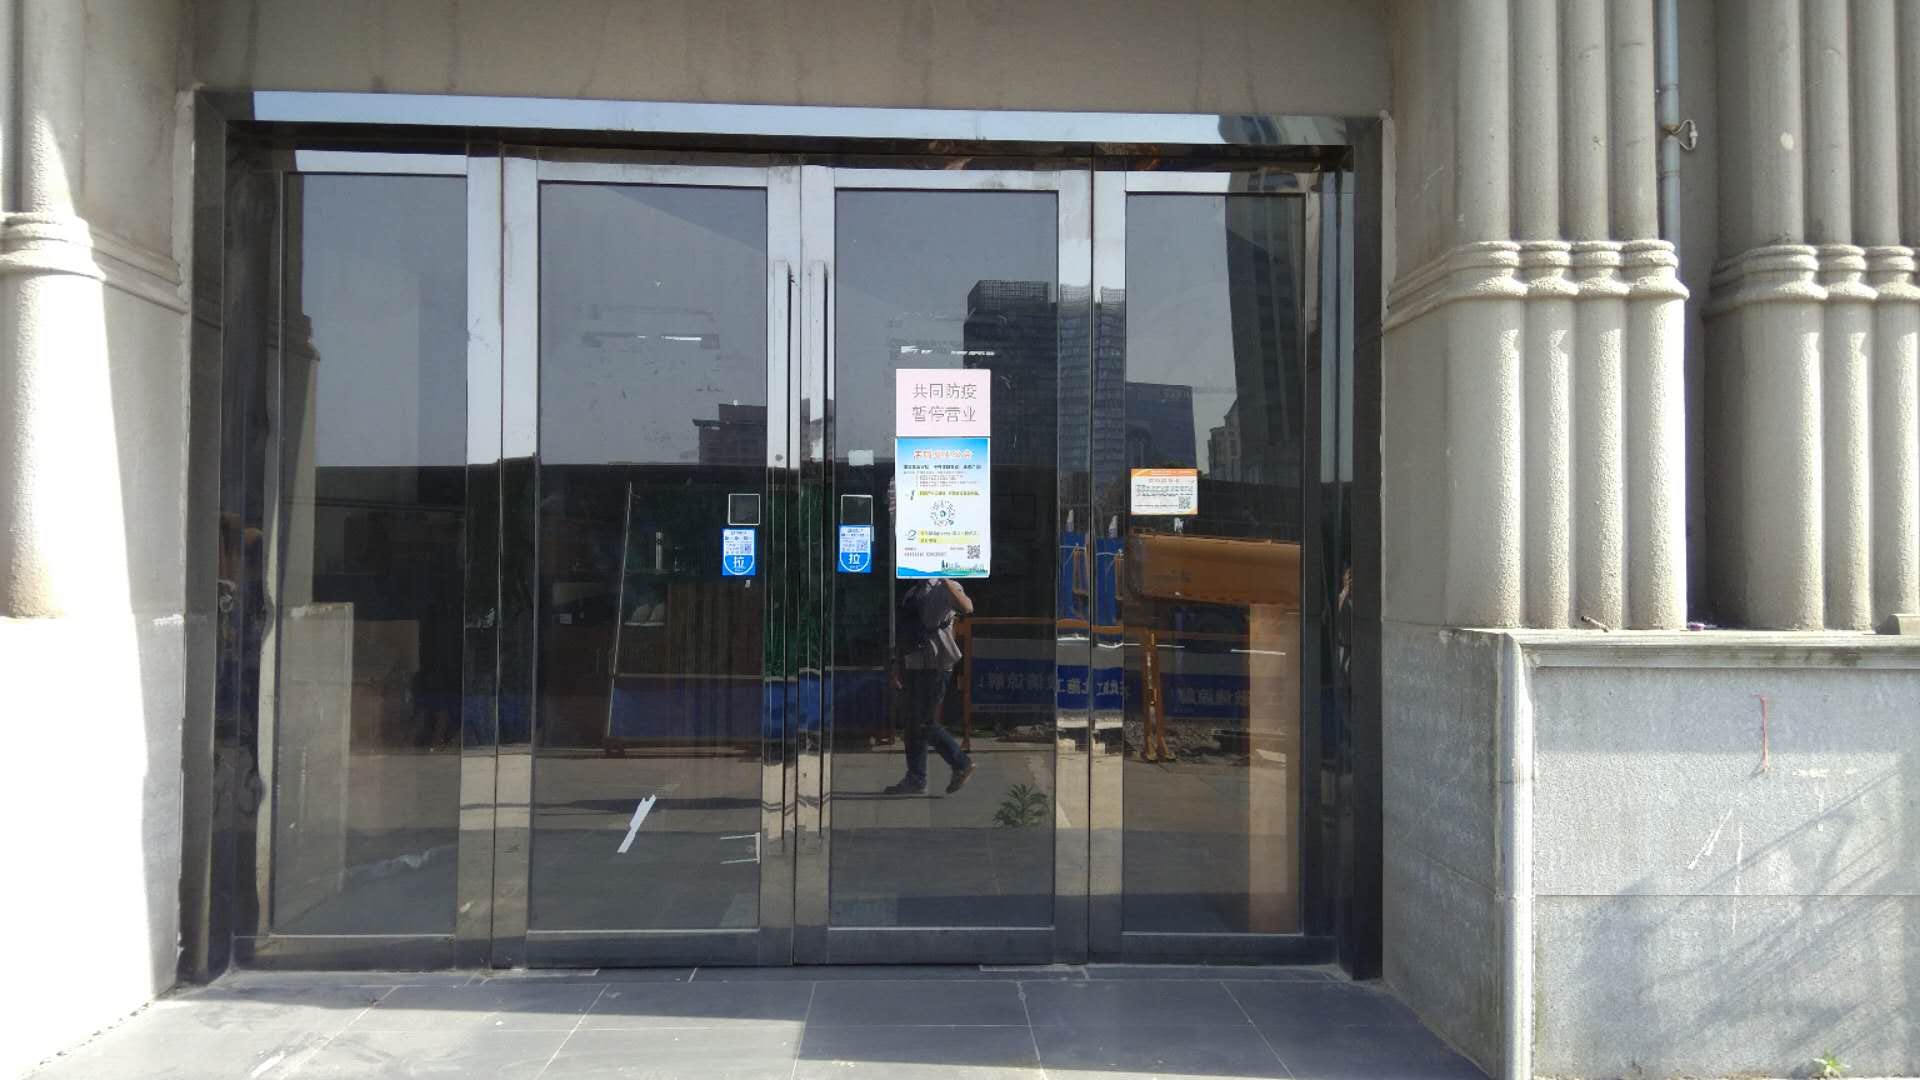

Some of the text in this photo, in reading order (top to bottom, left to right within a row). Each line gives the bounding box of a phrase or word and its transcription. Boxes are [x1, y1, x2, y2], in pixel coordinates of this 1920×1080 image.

[912, 383, 976, 399] 共同防疫
[912, 405, 976, 423] 暂停营业
[734, 555, 745, 568] 拉
[849, 554, 860, 565] 拉
